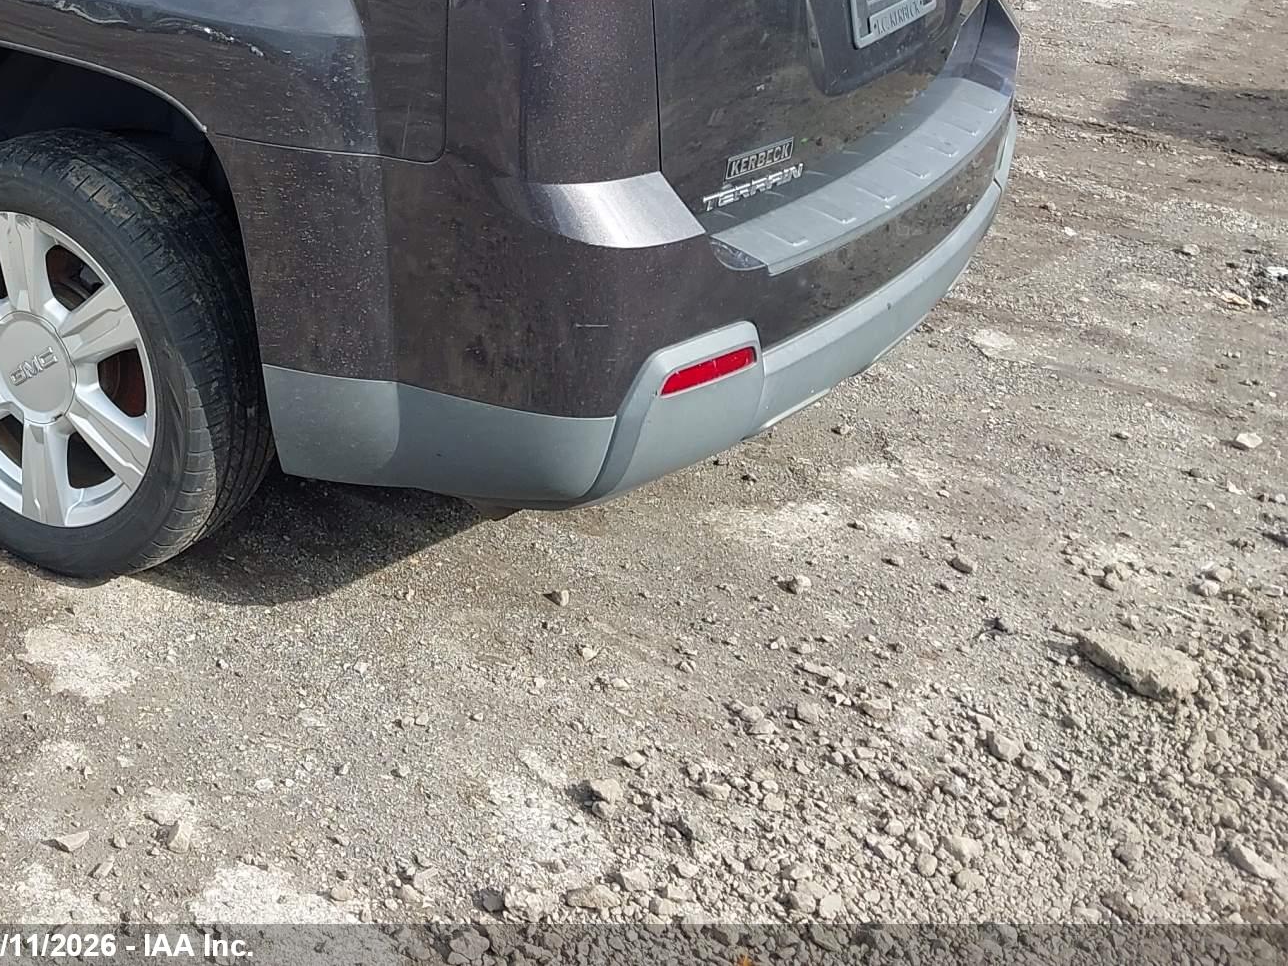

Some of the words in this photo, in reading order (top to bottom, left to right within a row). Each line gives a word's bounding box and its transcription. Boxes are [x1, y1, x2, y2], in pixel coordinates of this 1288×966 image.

[730, 142, 790, 176] KERBECK
[703, 163, 804, 211] TERRAIN
[9, 346, 59, 387] GMC
